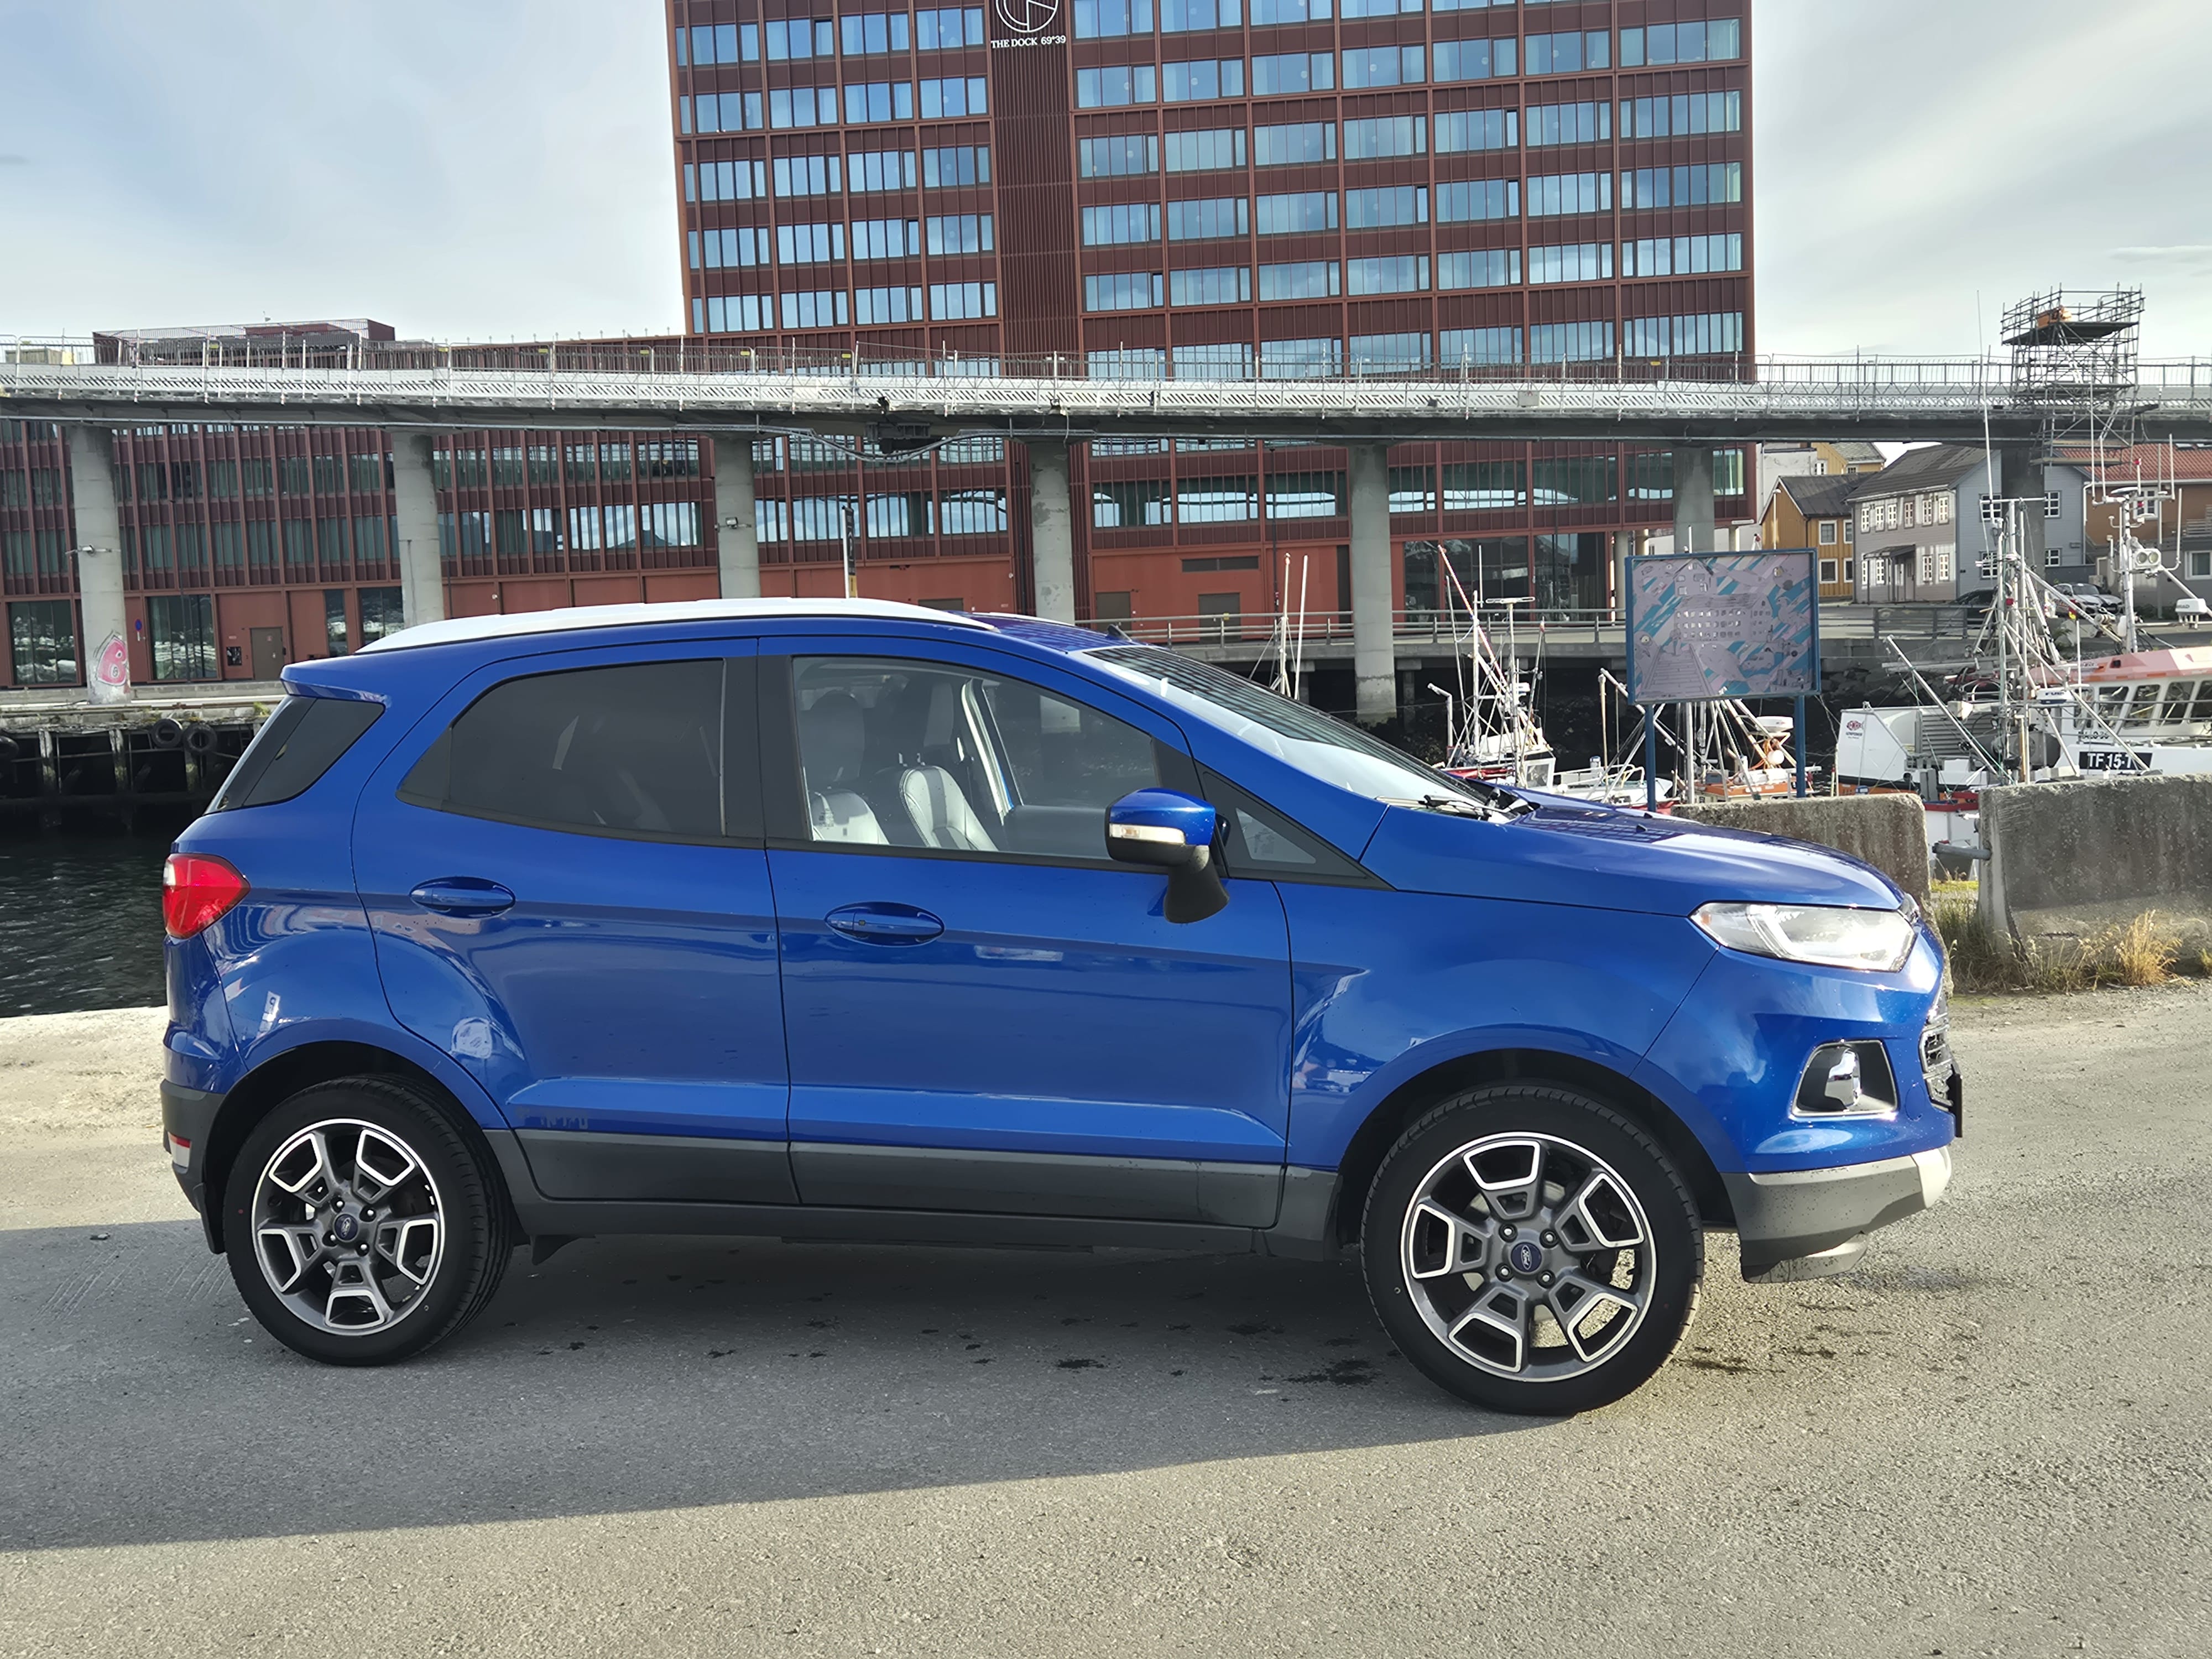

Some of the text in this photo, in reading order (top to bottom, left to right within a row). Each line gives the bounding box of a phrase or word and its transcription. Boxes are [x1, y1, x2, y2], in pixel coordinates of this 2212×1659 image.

[991, 39, 1009, 49] THE
[1011, 37, 1037, 48] DOCK
[2087, 753, 2105, 768] TF
